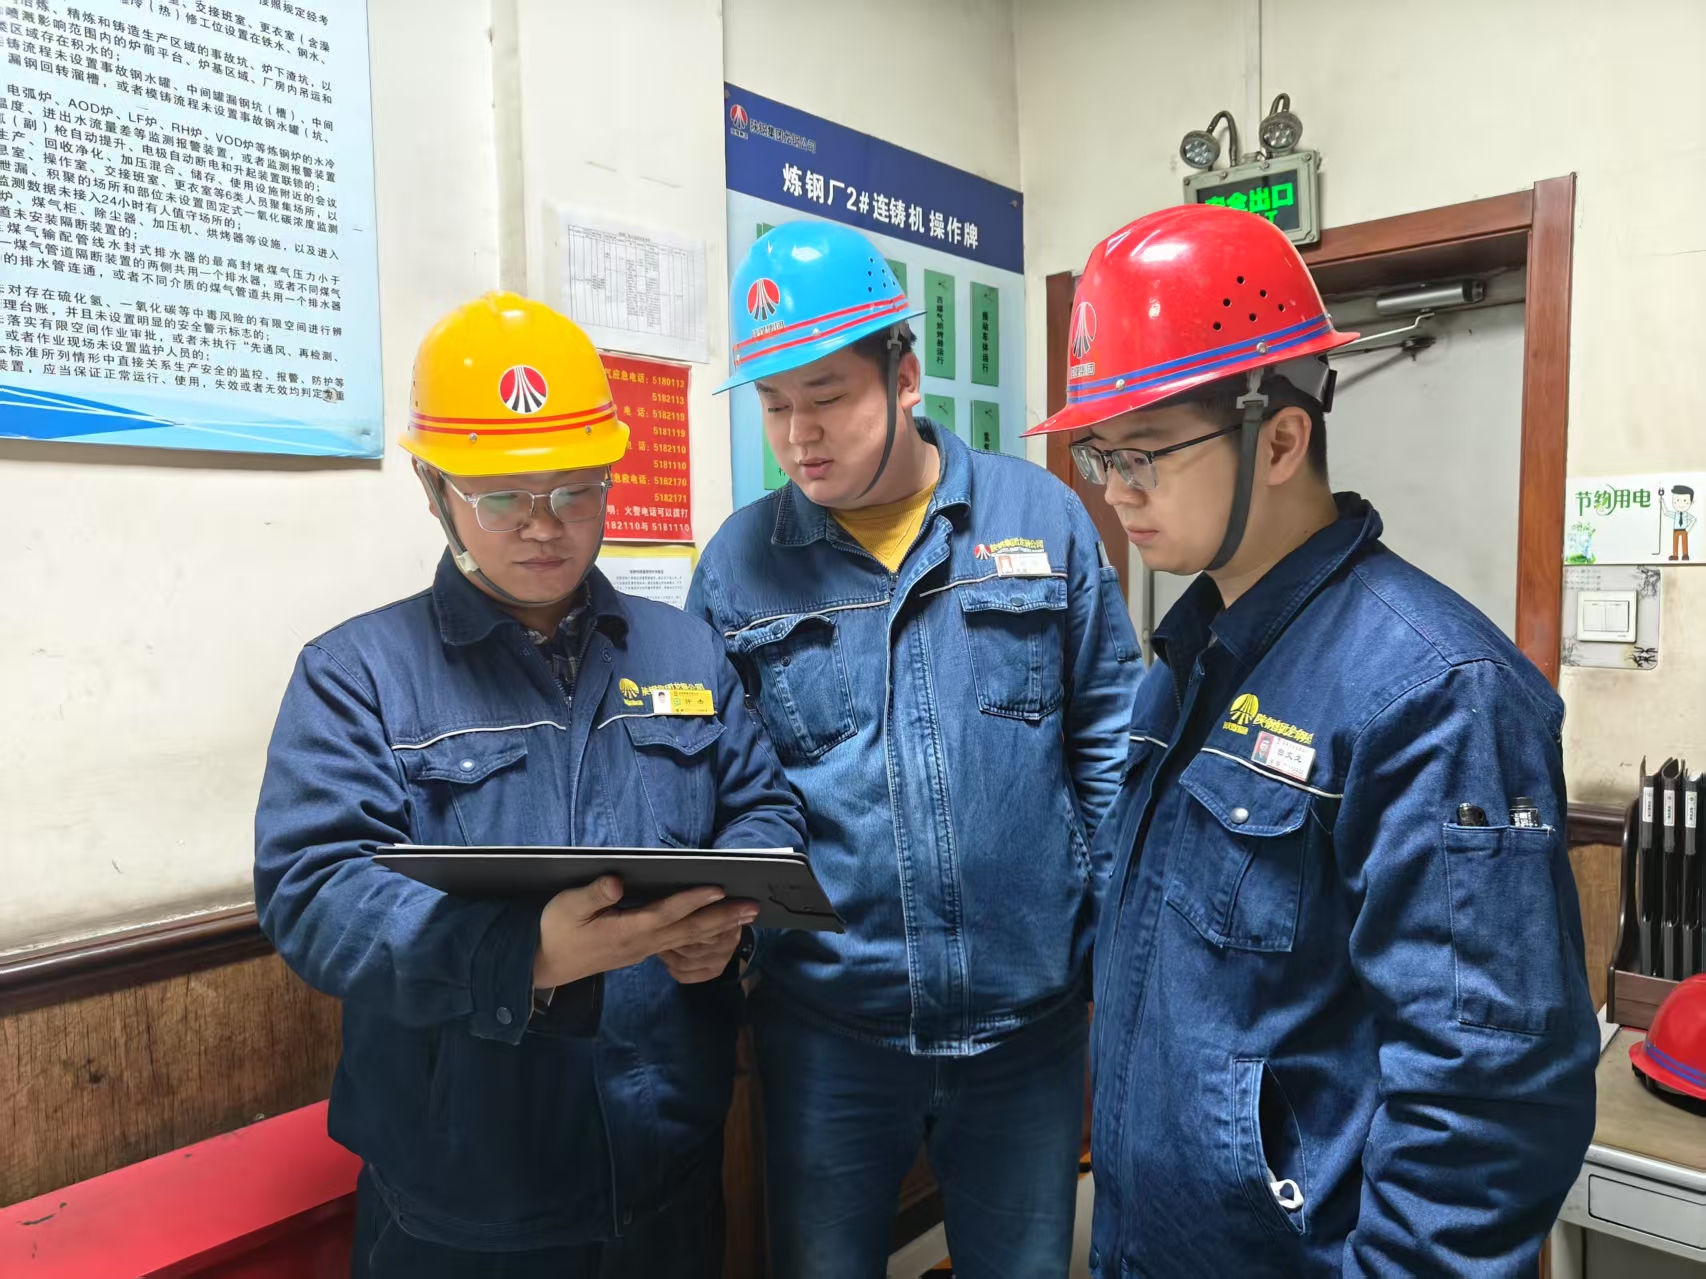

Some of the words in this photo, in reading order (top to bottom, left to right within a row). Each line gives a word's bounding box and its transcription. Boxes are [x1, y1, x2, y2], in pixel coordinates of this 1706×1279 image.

[652, 392, 685, 405] 5182113
[1575, 485, 1651, 516] 节约用电
